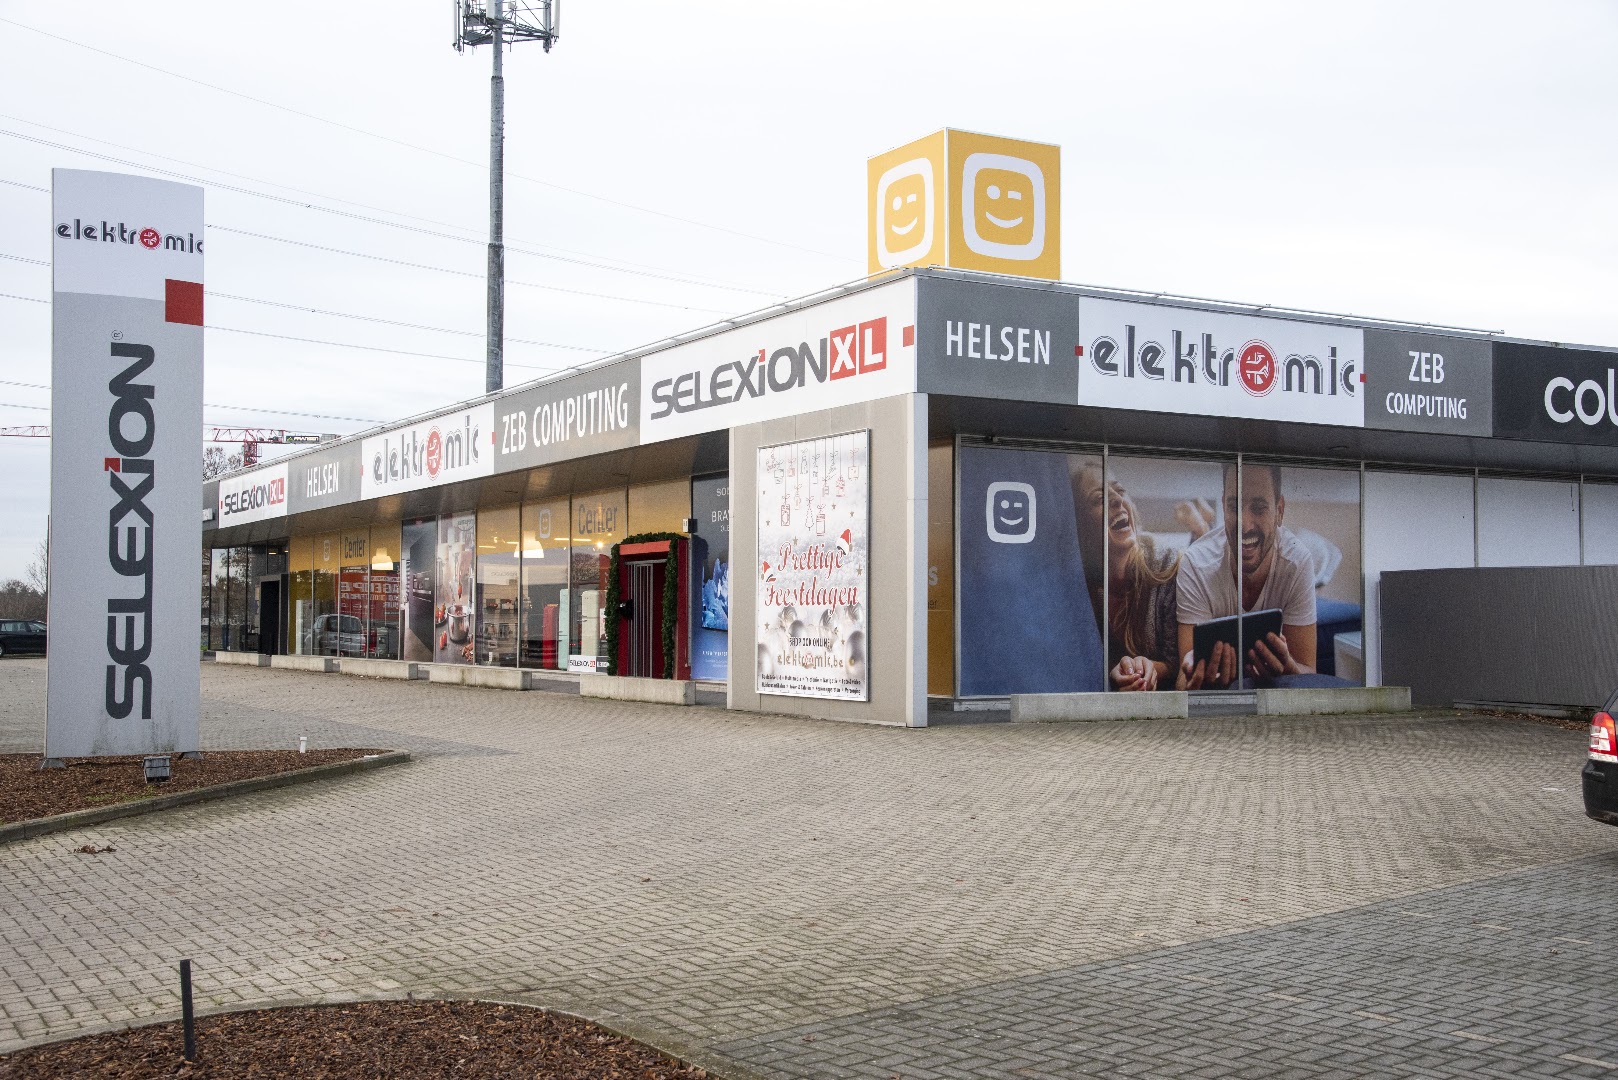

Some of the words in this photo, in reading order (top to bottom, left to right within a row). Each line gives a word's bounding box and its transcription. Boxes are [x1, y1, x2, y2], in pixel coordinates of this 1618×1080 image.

[831, 319, 884, 376] XL
[946, 320, 1051, 365] HELSEN
[1408, 350, 1445, 384] ZEB
[501, 410, 527, 455] ZEB
[532, 382, 628, 448] COMPUTING
[1386, 392, 1467, 420] COMPUTING
[306, 461, 340, 498] HELSEN
[578, 503, 618, 535] Center
[711, 509, 730, 523] BRA
[344, 536, 367, 560] Center
[777, 541, 844, 580] Prettige
[764, 576, 858, 615] Feestdagen
